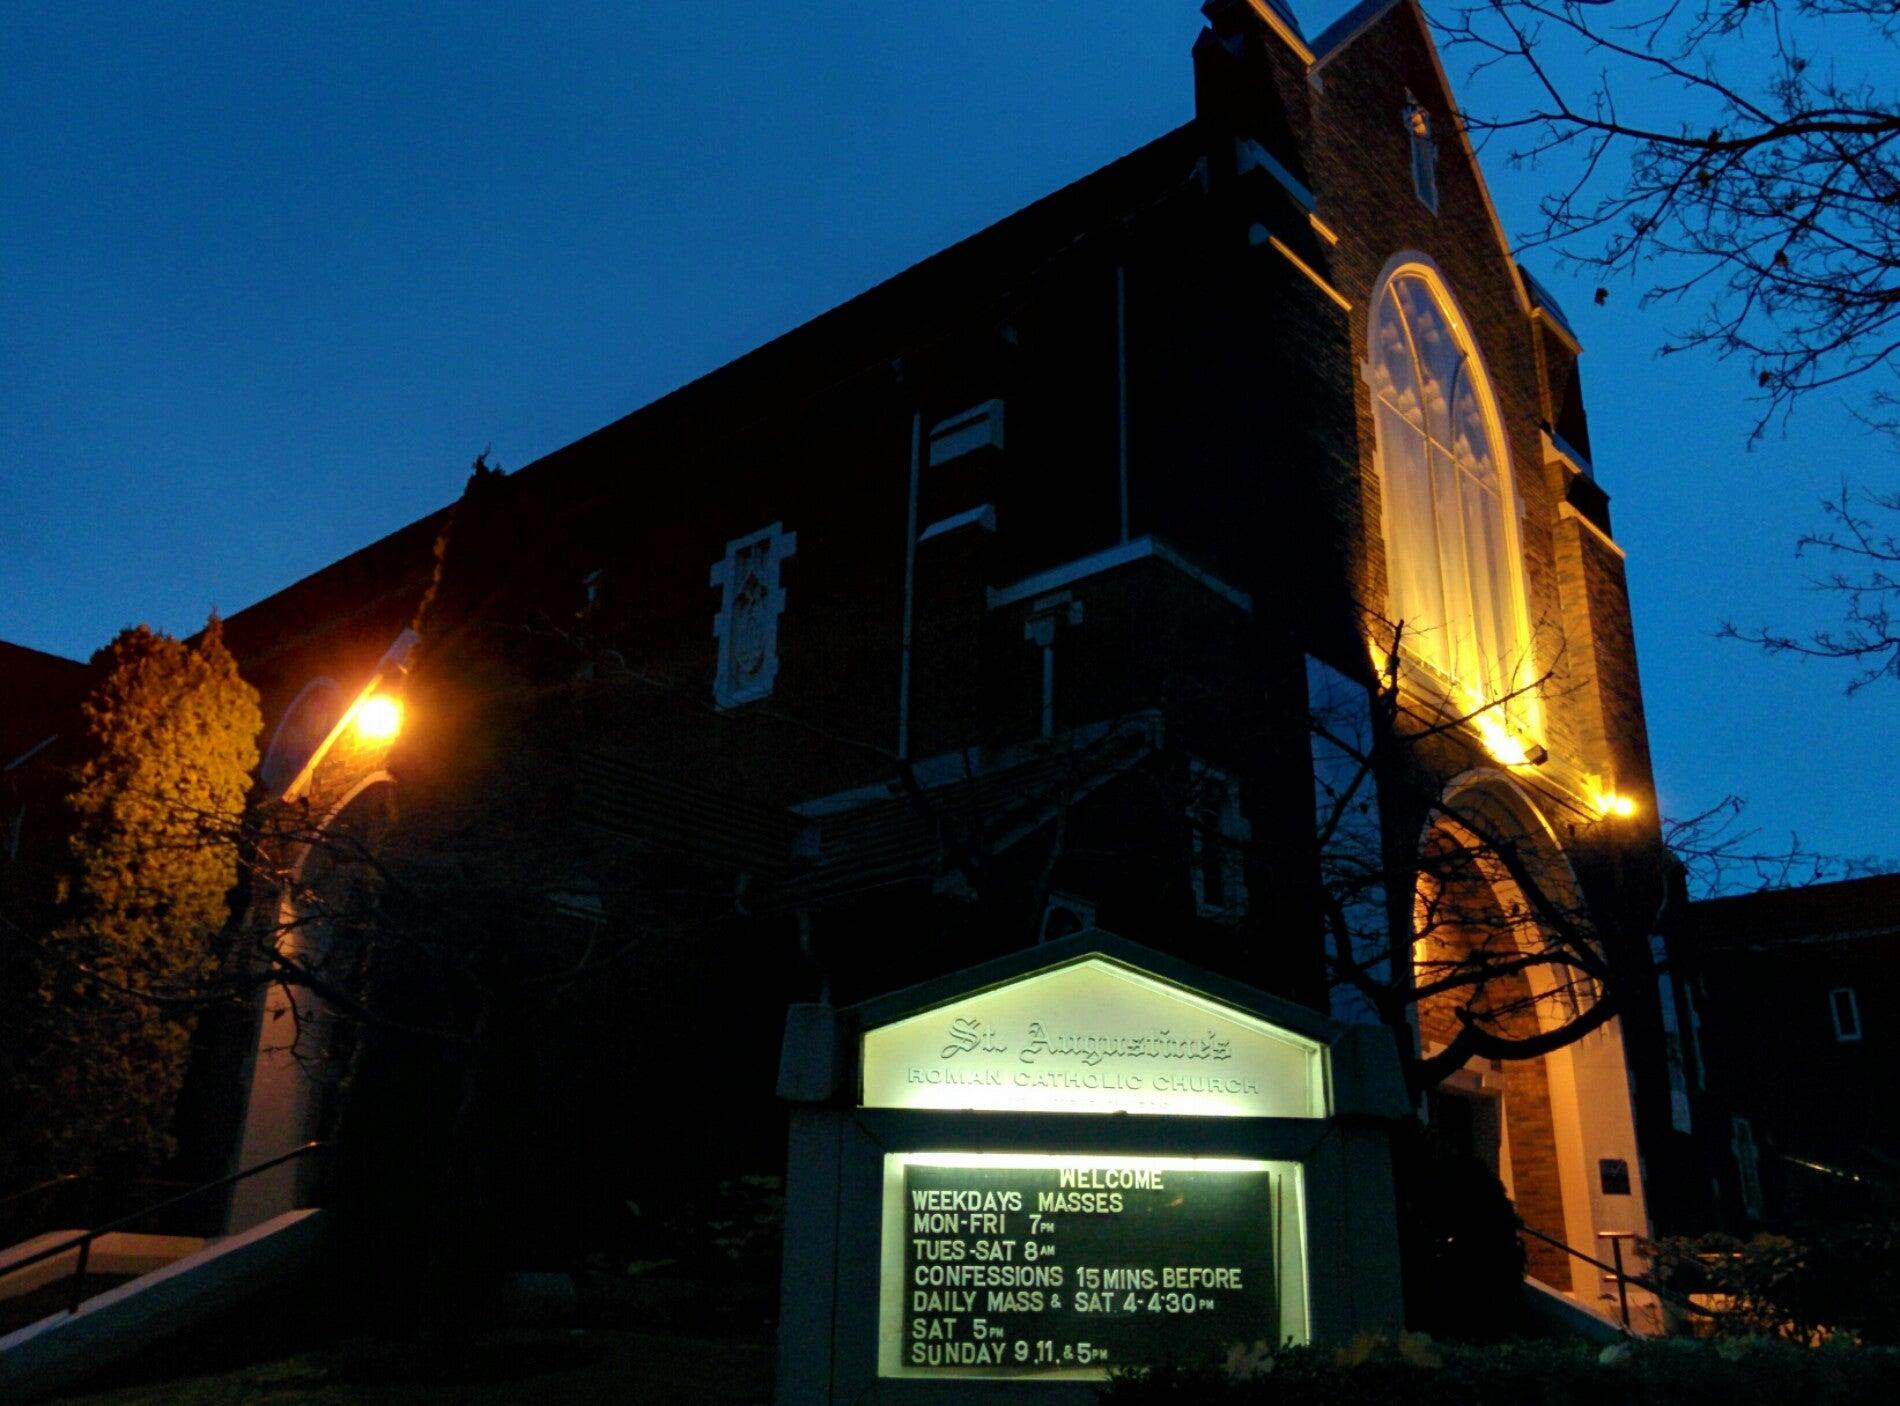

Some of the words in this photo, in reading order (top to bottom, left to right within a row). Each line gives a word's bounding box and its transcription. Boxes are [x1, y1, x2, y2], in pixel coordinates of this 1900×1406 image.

[1019, 1020, 1232, 1067] Augustine's
[908, 1067, 1001, 1086] ROMAN
[1013, 1071, 1142, 1091] CATHOLIC
[1153, 1074, 1260, 1094] CHURCH
[1060, 1169, 1164, 1190] WELCOME
[912, 1190, 1022, 1212] WEEKDAYS
[1038, 1191, 1124, 1213] MASSES
[913, 1213, 1006, 1234] MON-FRI
[914, 1265, 1064, 1287] CONFESSIONS
[1162, 1267, 1243, 1289] BEFORE
[913, 1290, 977, 1312] DAILY
[987, 1290, 1044, 1313] MASS
[1051, 1293, 1062, 1309] &
[912, 1318, 957, 1340] SAT
[911, 1342, 1006, 1366] SUNDAY
